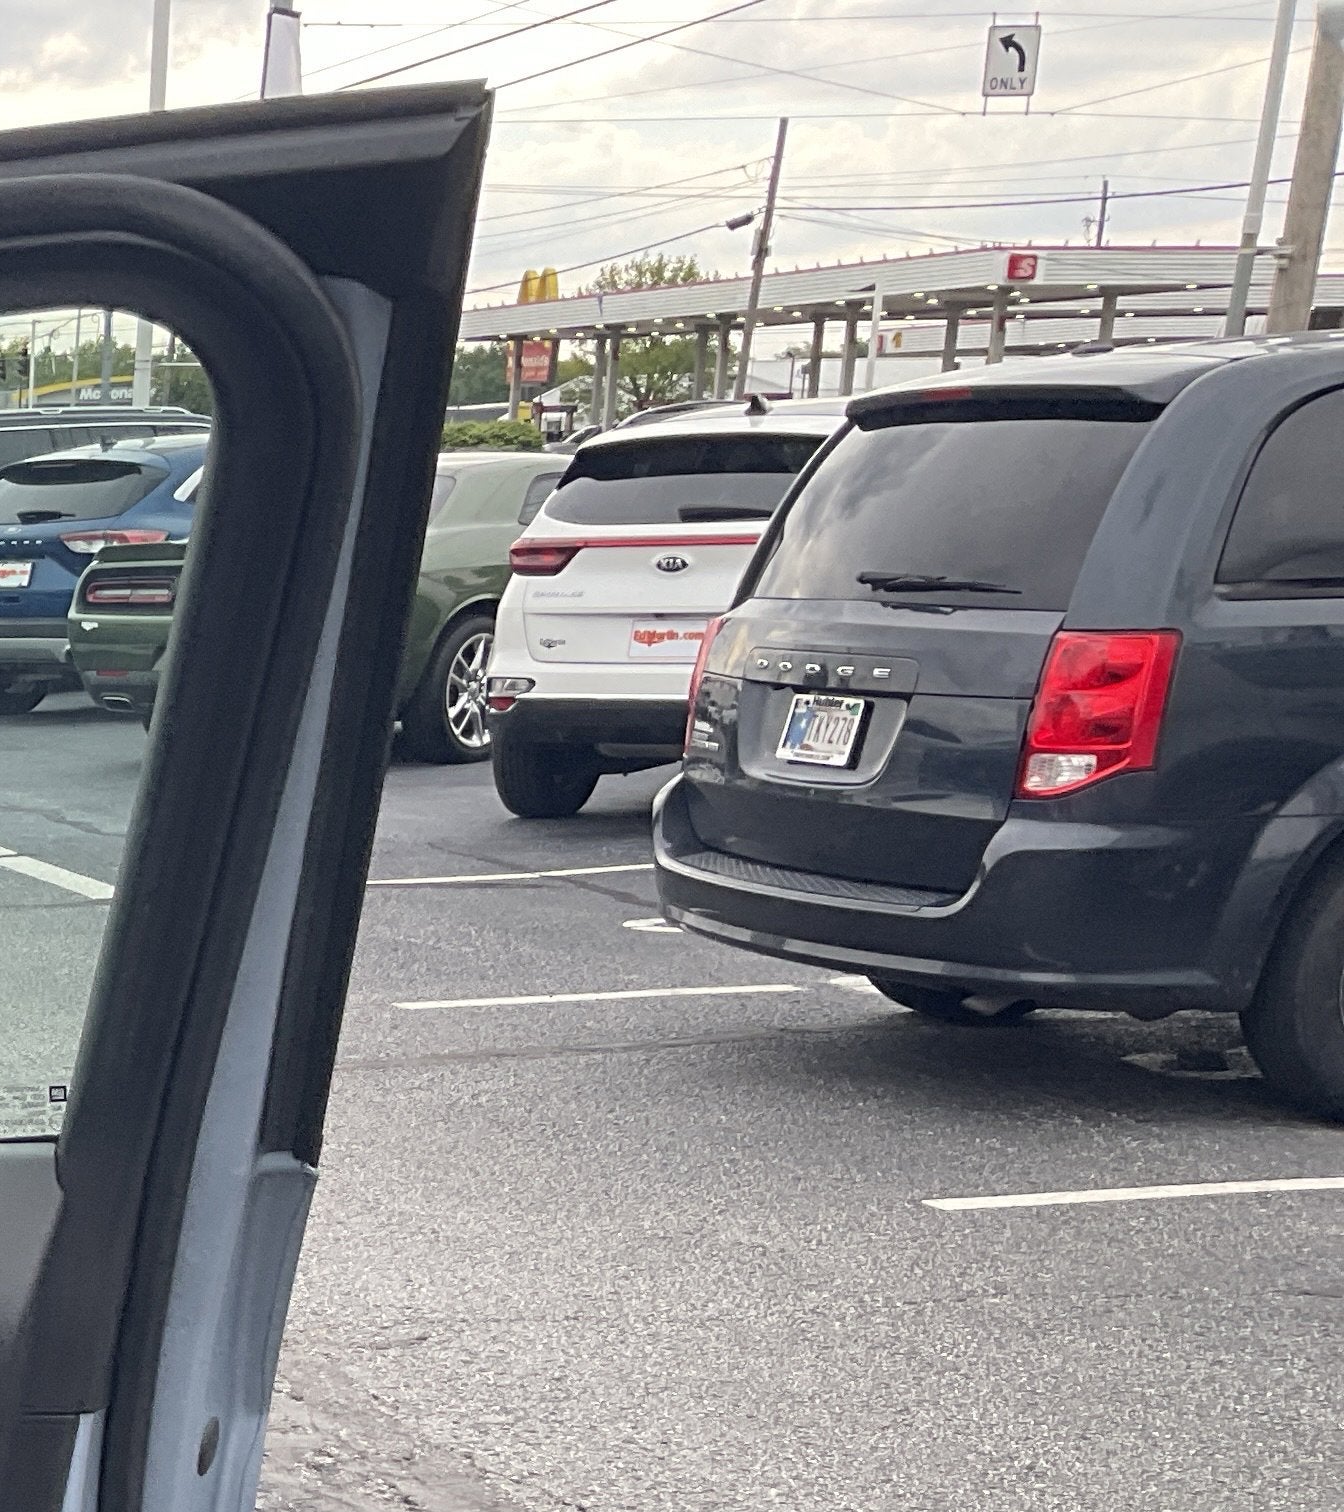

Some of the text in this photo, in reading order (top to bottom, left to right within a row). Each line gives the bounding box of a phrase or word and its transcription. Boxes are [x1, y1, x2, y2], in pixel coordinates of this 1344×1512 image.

[989, 77, 1028, 90] ONLY
[660, 557, 684, 570] KIA
[755, 657, 892, 679] DODGE
